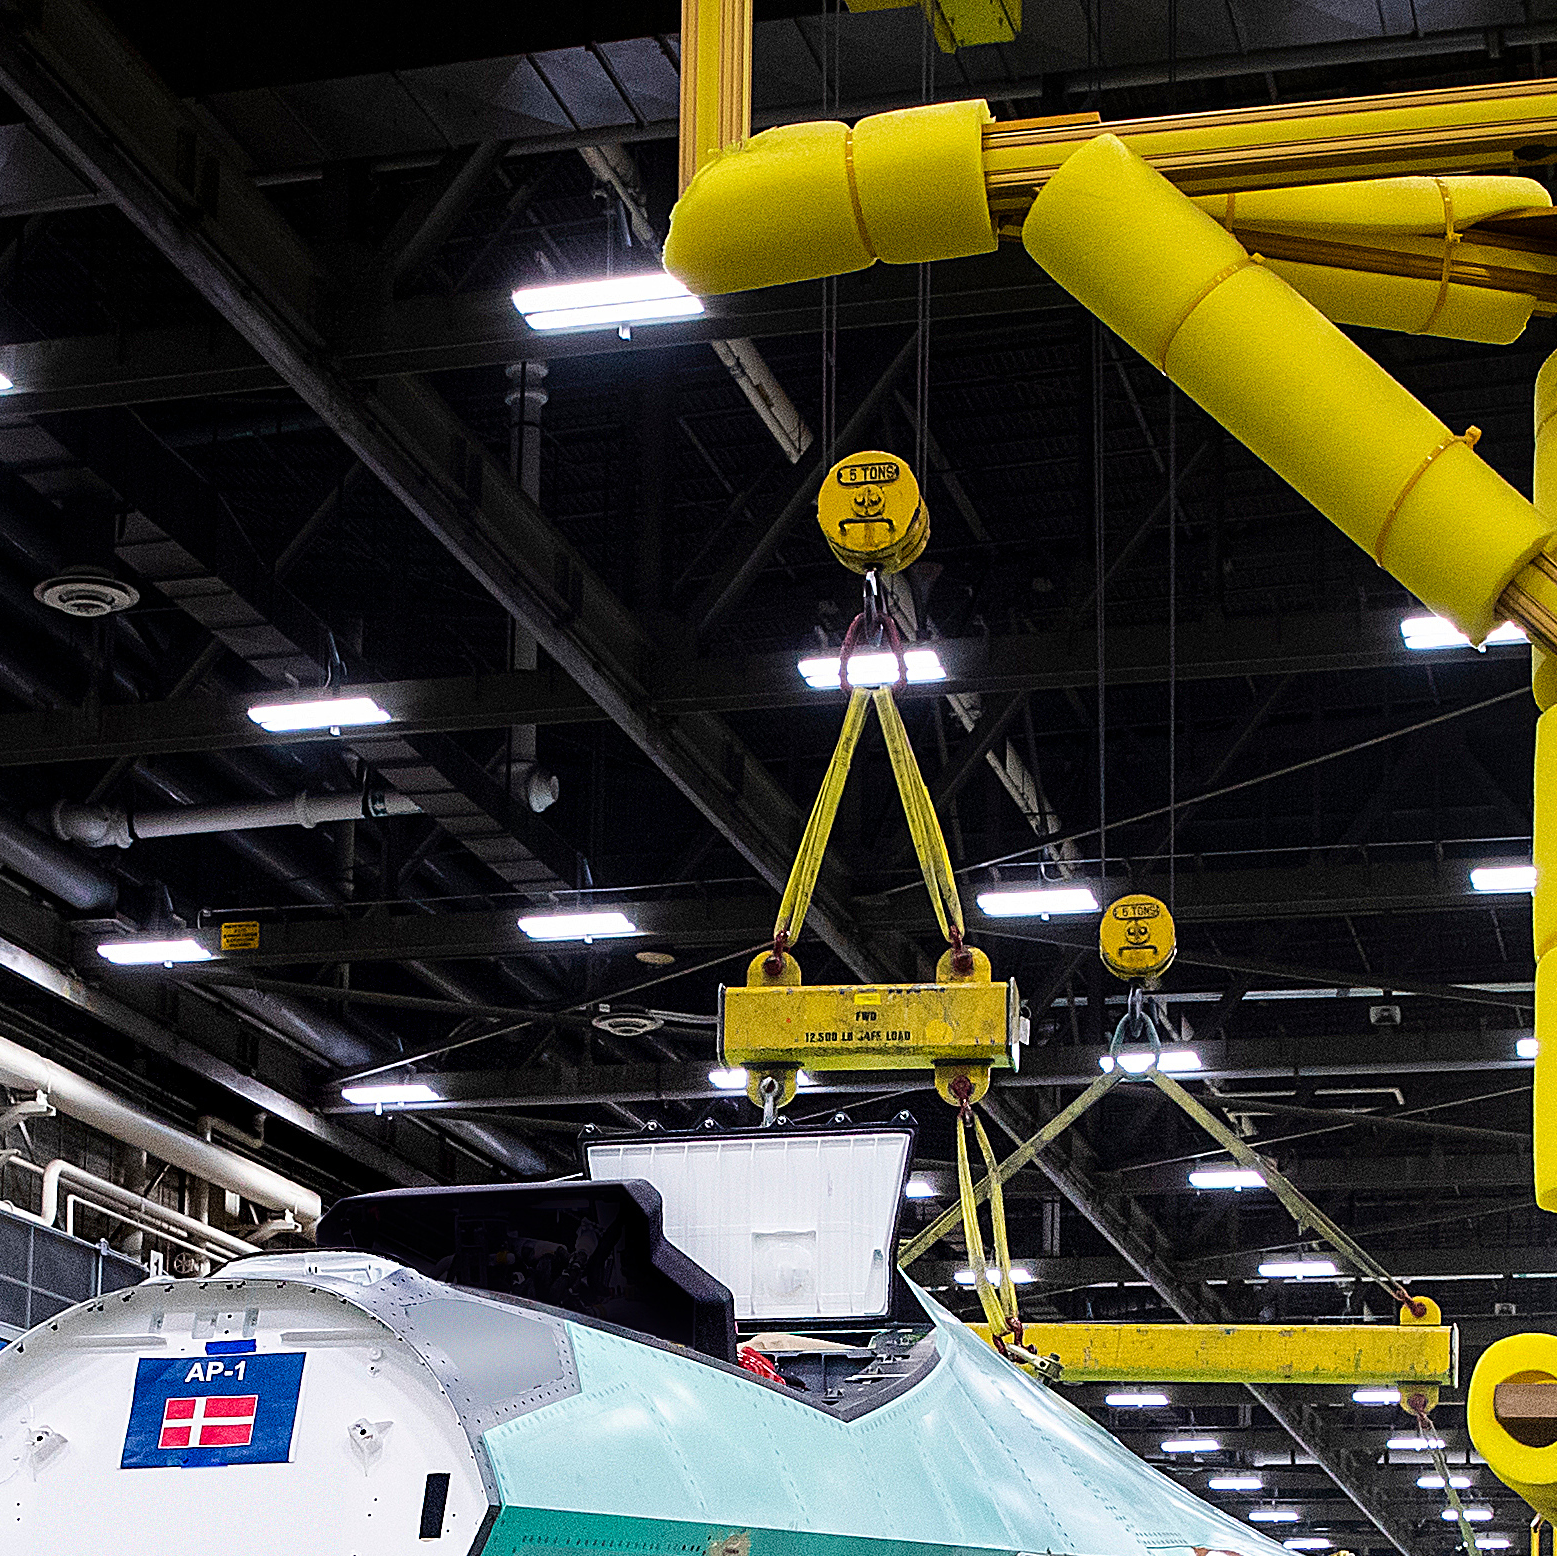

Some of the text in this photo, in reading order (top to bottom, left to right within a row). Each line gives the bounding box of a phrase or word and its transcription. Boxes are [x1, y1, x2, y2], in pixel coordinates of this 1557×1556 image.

[849, 465, 895, 481] 5 TONS
[1122, 904, 1158, 917] 5 TONS
[855, 1011, 877, 1021] FWD
[842, 1031, 853, 1041] LB
[886, 1030, 911, 1041] LOAD
[185, 1361, 245, 1382] AP-1
